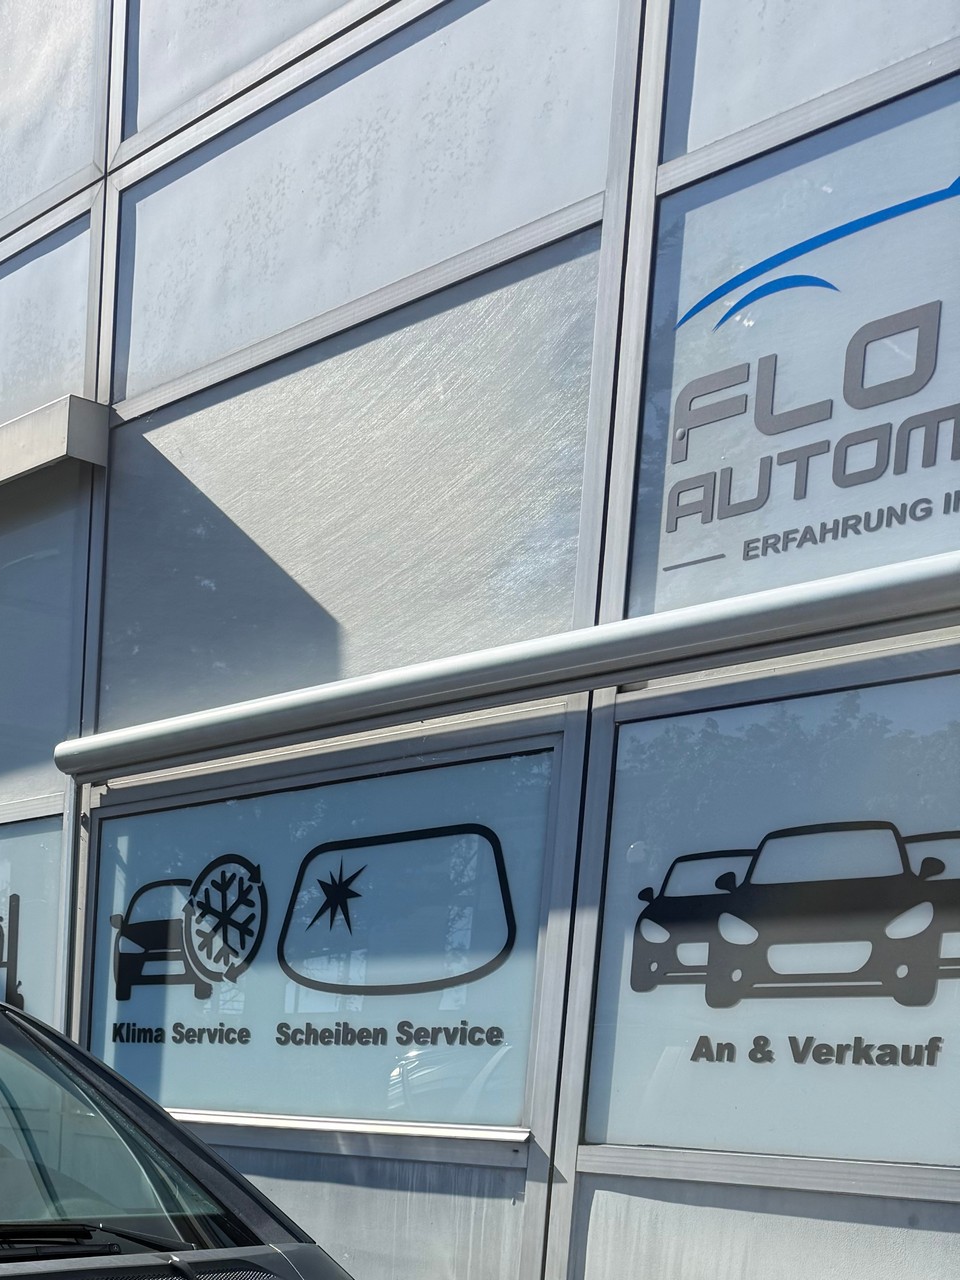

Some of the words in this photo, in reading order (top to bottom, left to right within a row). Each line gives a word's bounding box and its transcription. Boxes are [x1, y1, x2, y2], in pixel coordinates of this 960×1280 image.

[671, 300, 942, 464] FLO
[665, 403, 960, 533] AUTOM
[742, 498, 933, 561] ERFAHRUNG
[112, 1022, 165, 1044] Klima
[171, 1022, 251, 1045] Service
[276, 1021, 388, 1046] Scheiben
[396, 1020, 504, 1046] Service
[690, 1035, 737, 1063] An
[748, 1035, 776, 1064] &
[788, 1035, 944, 1067] Verkauf
